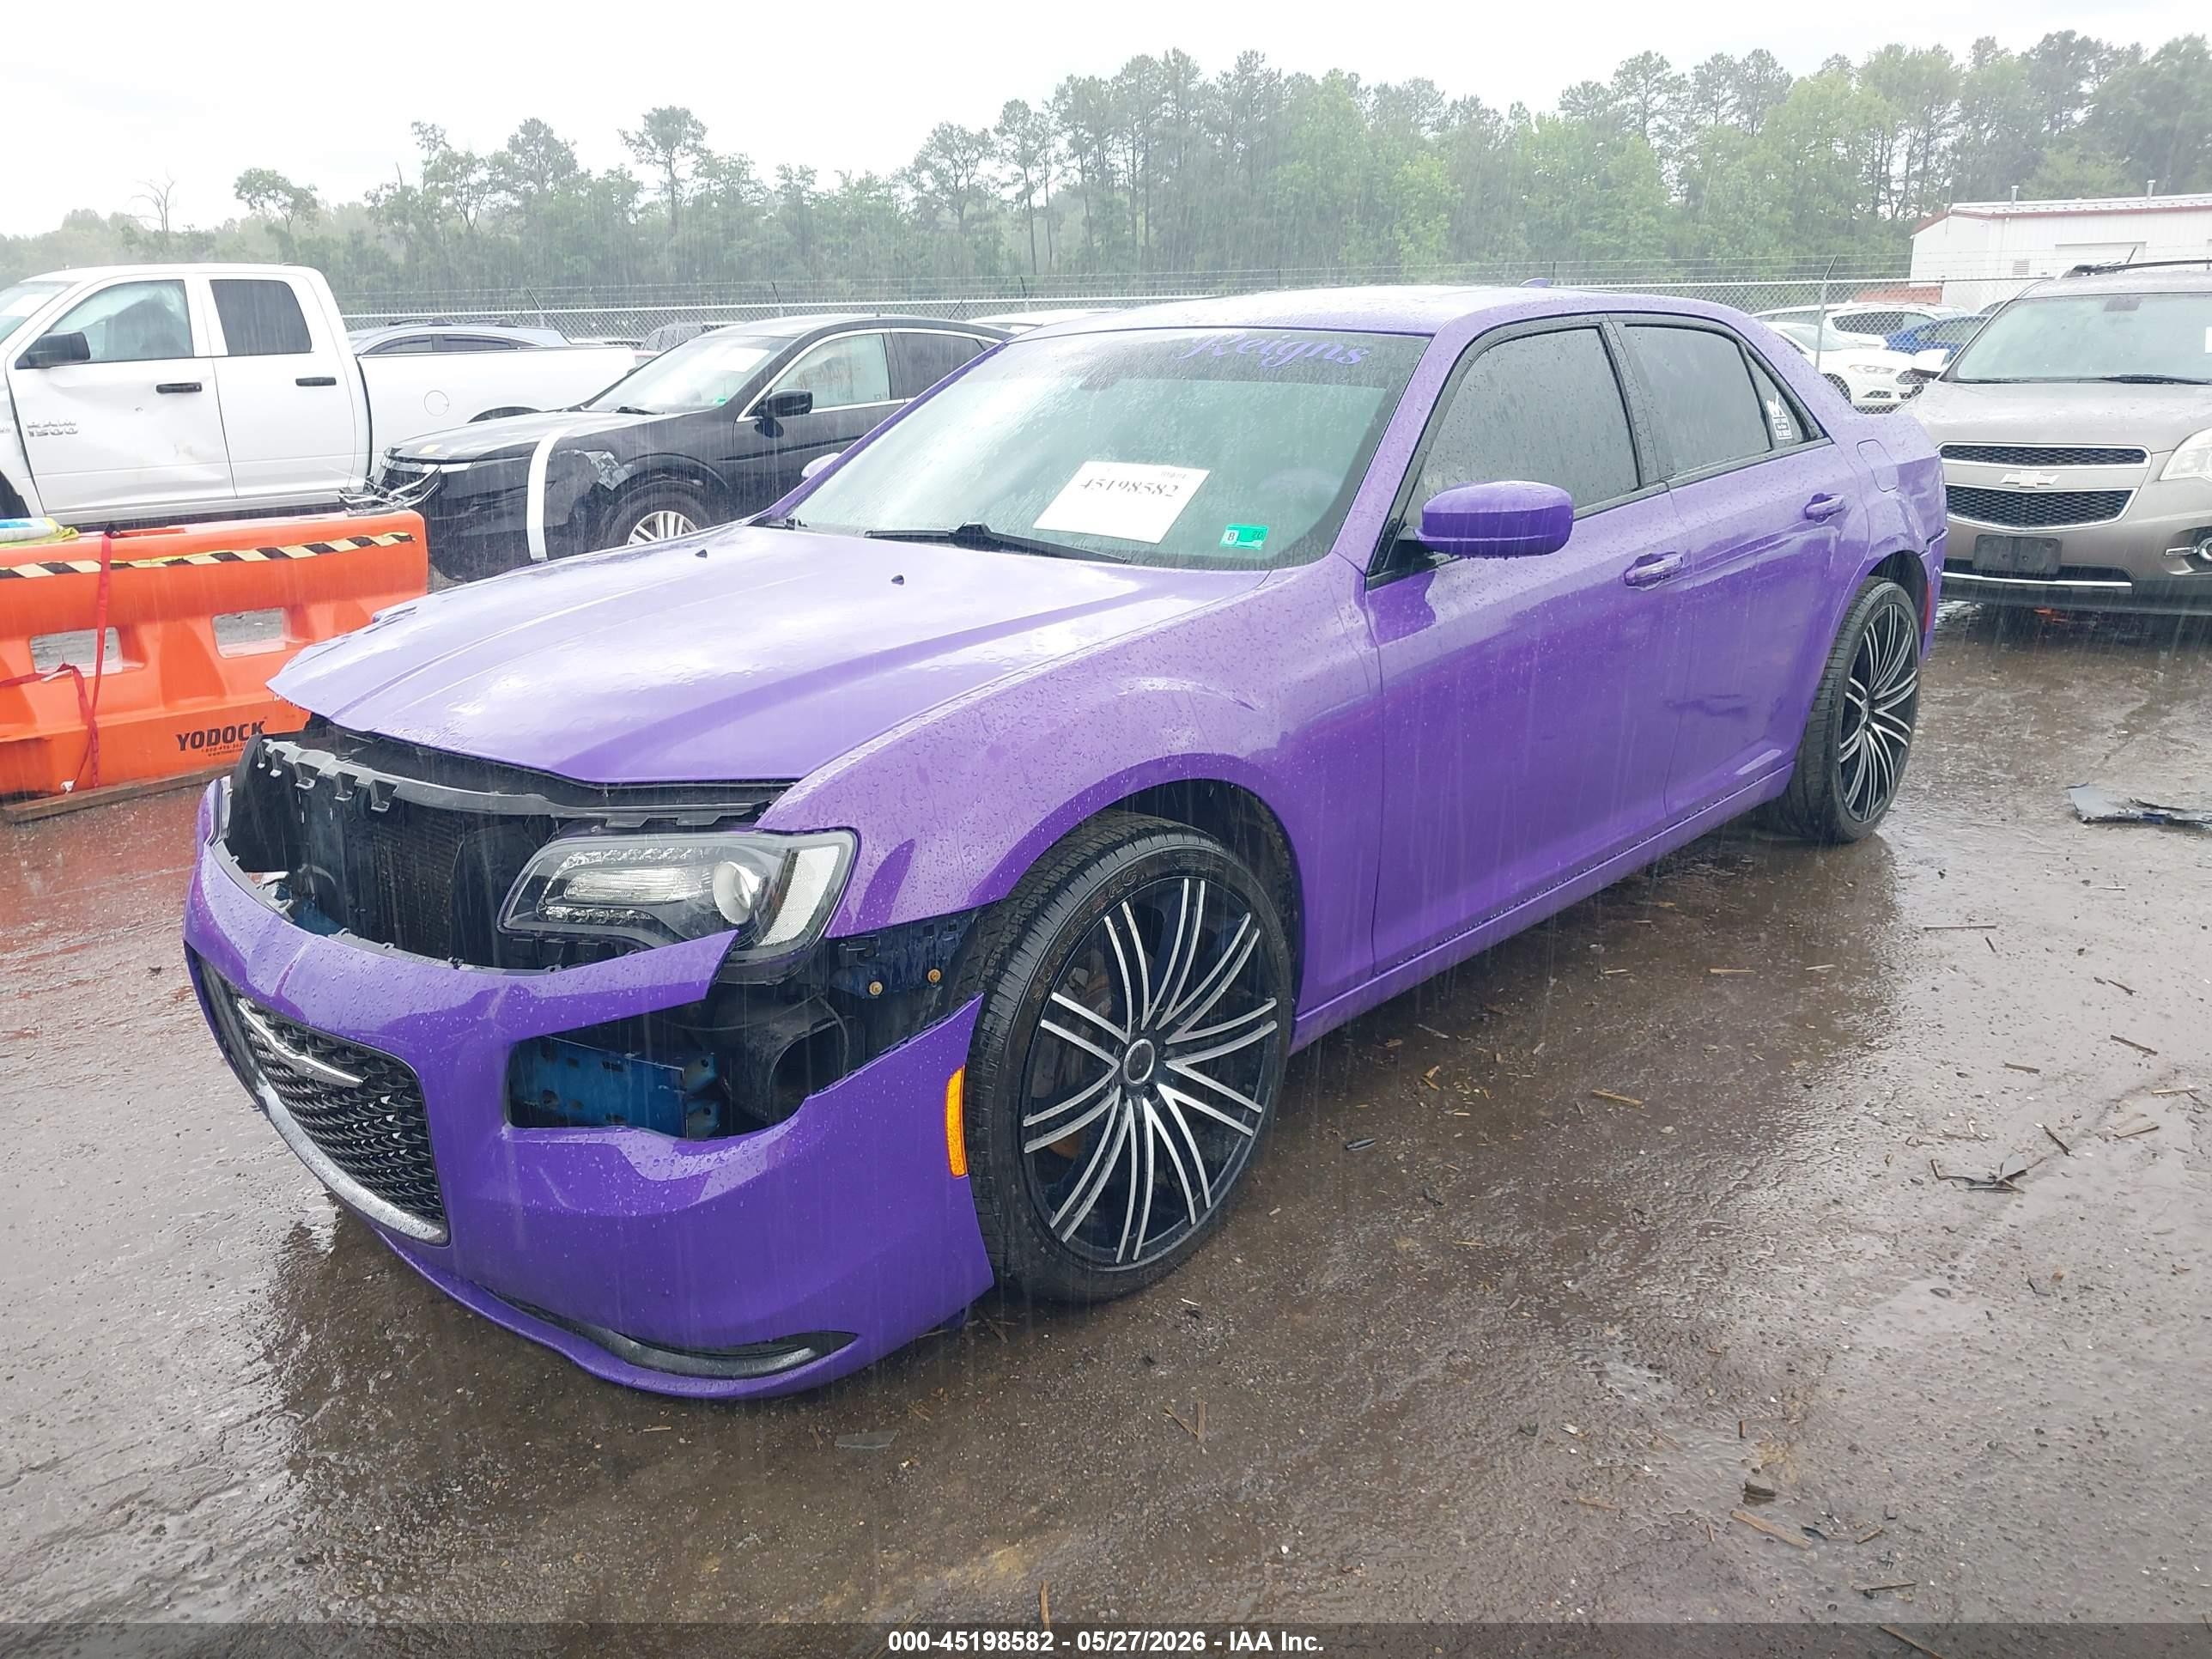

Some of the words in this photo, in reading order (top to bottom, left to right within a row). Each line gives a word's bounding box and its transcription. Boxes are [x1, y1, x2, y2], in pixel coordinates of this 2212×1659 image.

[1173, 331, 1370, 368] Reigns
[1079, 478, 1179, 497] 45198582
[1228, 532, 1236, 541] 8
[176, 721, 265, 751] YODOCK
